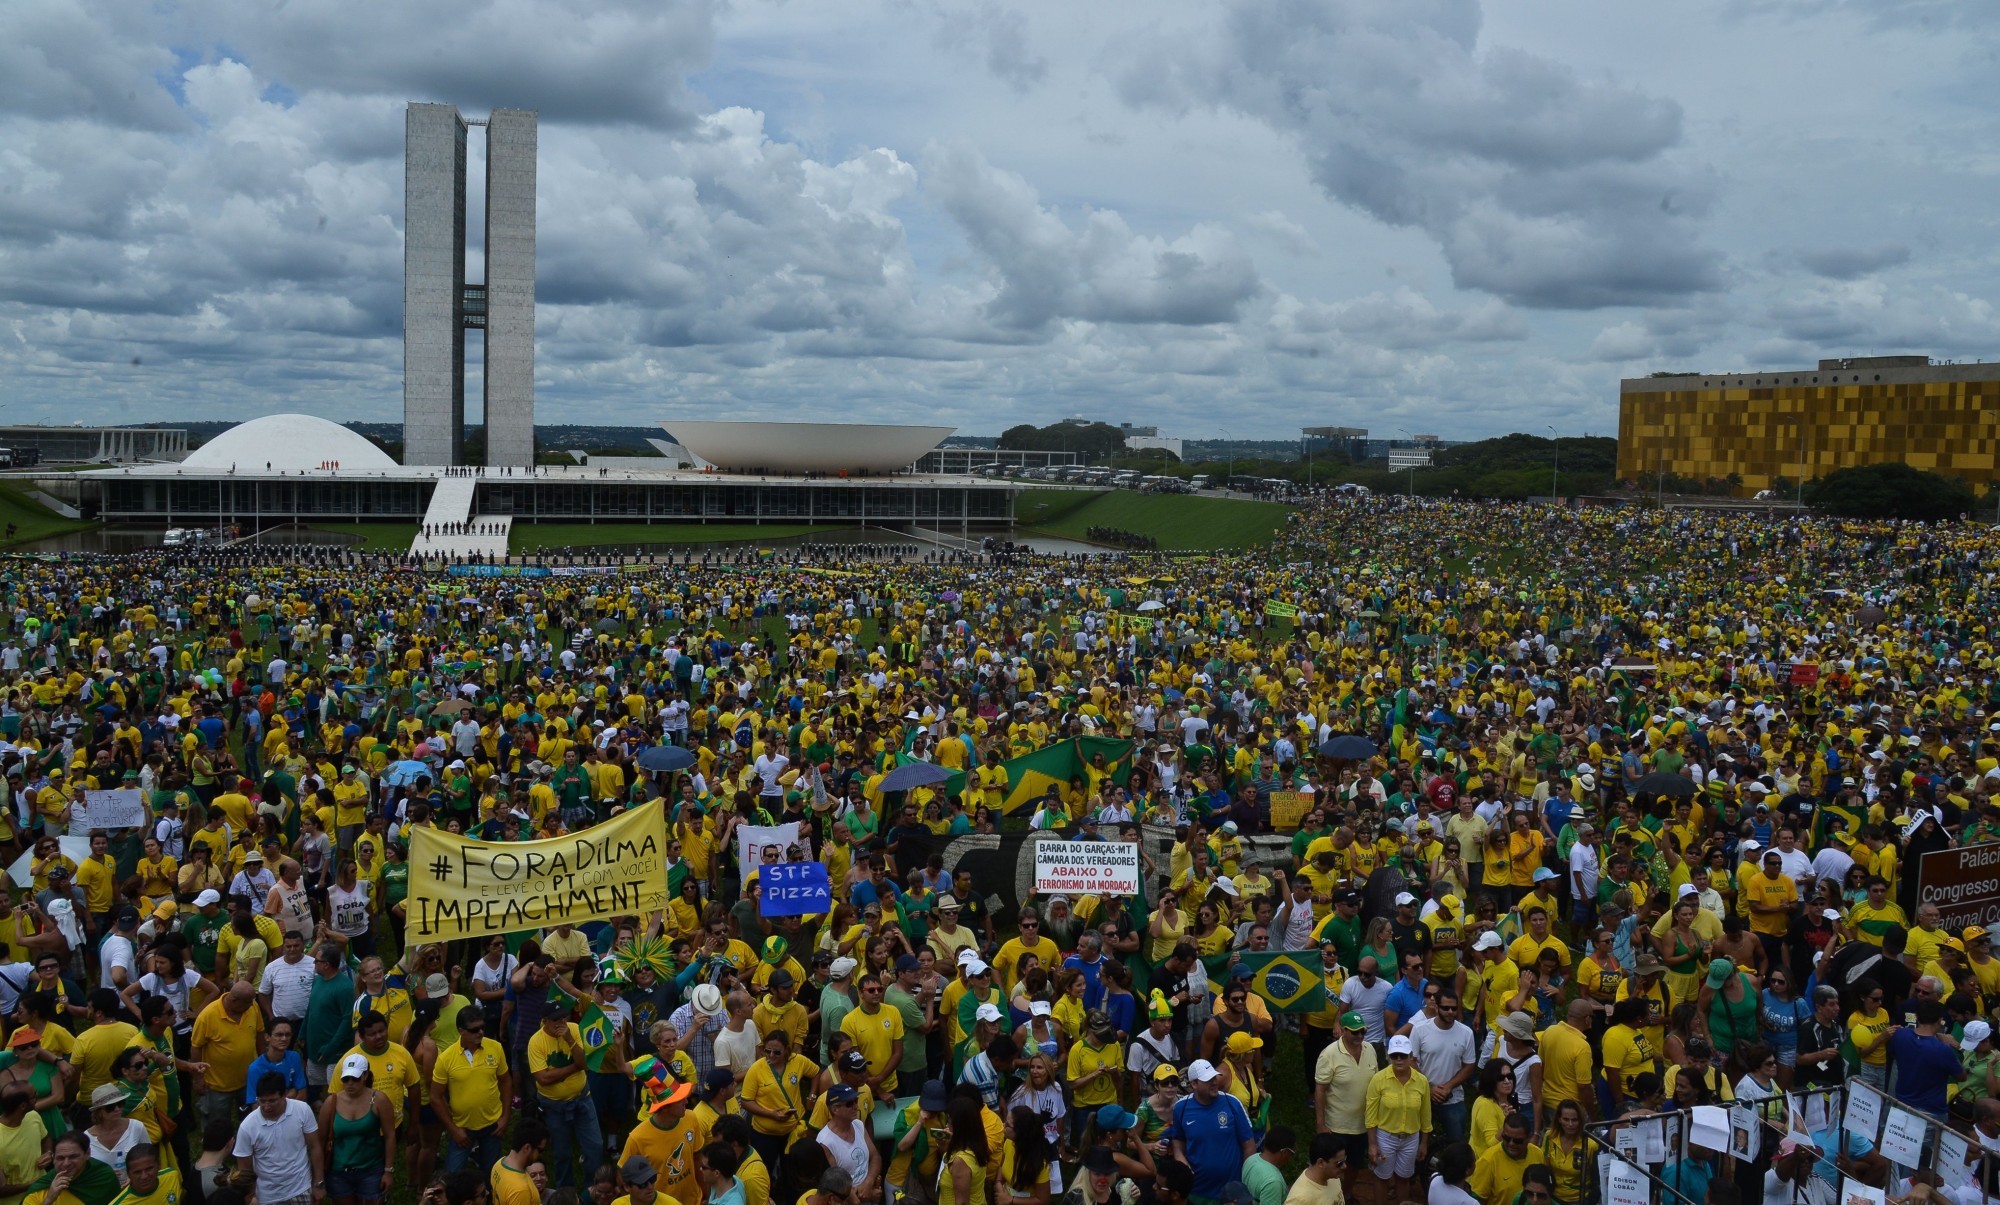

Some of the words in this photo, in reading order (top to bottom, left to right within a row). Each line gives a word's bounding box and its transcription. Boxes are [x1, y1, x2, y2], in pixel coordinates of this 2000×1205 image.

[1039, 843, 1067, 853] BARRA
[1070, 844, 1082, 853] DO
[1084, 844, 1132, 855] GARÇAS-MT
[1071, 855, 1085, 865] DOS
[1086, 856, 1136, 866] VEREADORES
[769, 865, 811, 881] STF
[1051, 867, 1097, 877] ABAIXO
[1104, 867, 1113, 877] O
[481, 885, 489, 897] E
[497, 881, 529, 896] LEVE
[535, 880, 545, 893] O
[553, 872, 576, 891] PT
[582, 868, 614, 887] COM
[1037, 878, 1084, 890] TERRORISMO
[1086, 880, 1097, 890] DA
[1097, 879, 1137, 893] MORDAÇA!
[768, 886, 828, 901] PIZZA
[1922, 878, 1998, 903] Congresso
[336, 901, 365, 911] FORA
[416, 880, 646, 936] IMPEACHMENT
[1986, 904, 2000, 923] C
[1938, 907, 1984, 931] ational
[1613, 1176, 1638, 1185] EDISON
